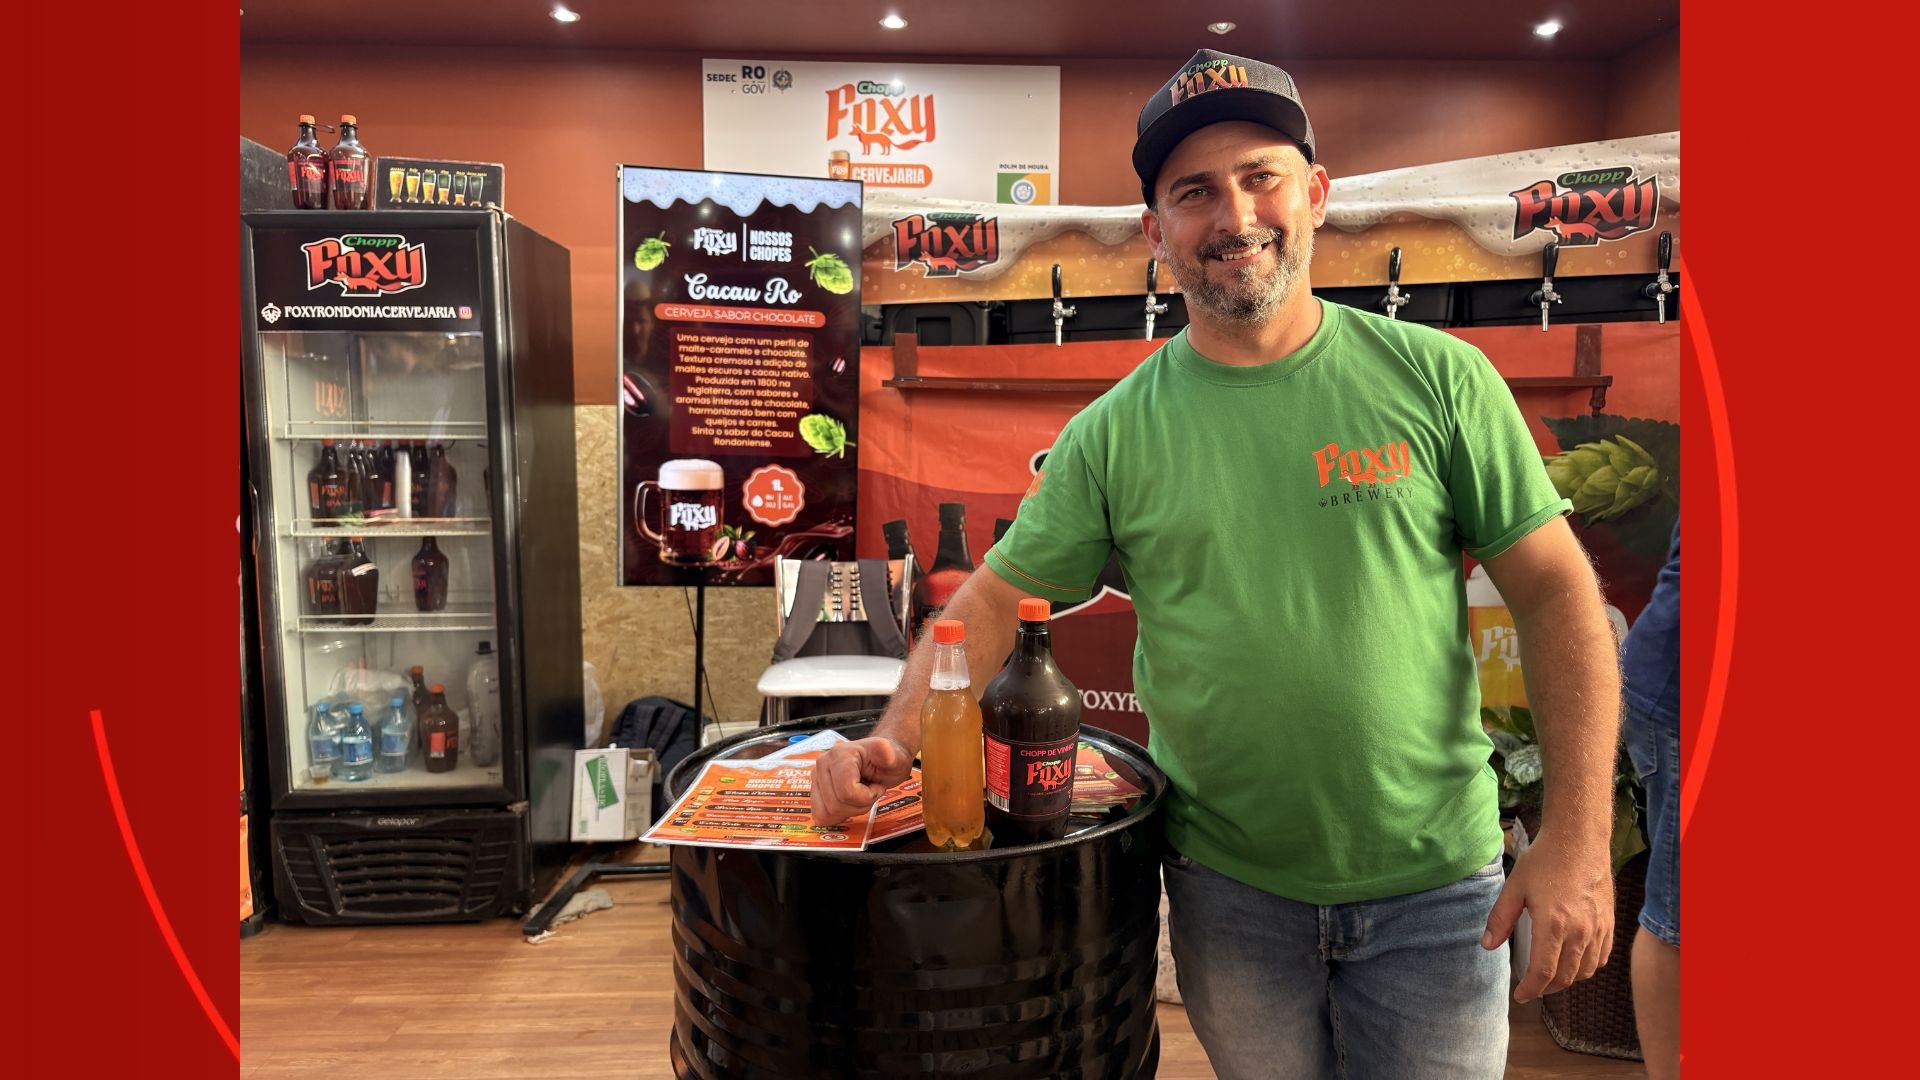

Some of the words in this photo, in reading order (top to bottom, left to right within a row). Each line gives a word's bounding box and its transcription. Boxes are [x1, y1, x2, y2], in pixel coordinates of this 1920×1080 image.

[742, 65, 765, 79] RO
[1187, 59, 1229, 75] Chopp
[706, 73, 737, 82] SEDEC
[742, 84, 766, 94] GOV
[825, 84, 935, 141] Foxy
[853, 167, 925, 184] CERVEJARIA
[1561, 171, 1625, 186] Chopp
[929, 212, 976, 220] Chopp
[1513, 181, 1654, 239] Foxy
[345, 236, 398, 248] Chopp
[693, 227, 737, 253] Foxy
[750, 230, 793, 247] NOSSOS
[894, 215, 997, 266] Foxy
[750, 246, 792, 262] CHOPES
[304, 240, 423, 289] Foxy
[684, 273, 761, 302] Cacau
[764, 277, 802, 304] Ro
[284, 306, 457, 319] FOXYRONDONIACERVEJARIA
[664, 307, 713, 319] CERVEJA
[714, 309, 751, 321] SABOR
[752, 311, 816, 324] CHOCOLATE
[677, 334, 699, 342] Uma
[701, 336, 733, 345] cerveja
[774, 338, 794, 348] perfil
[679, 344, 752, 355] malte-caramelo
[762, 348, 807, 358] chocolate.
[679, 355, 712, 363] Textura
[714, 357, 753, 365] cremosa
[763, 358, 793, 368] adição
[795, 360, 806, 368] de
[675, 365, 706, 374] maltes
[708, 367, 742, 375] escuros
[782, 370, 810, 379] nativo.
[696, 376, 739, 385] Produzida
[758, 379, 777, 387] 1800
[688, 386, 733, 397] Inglaterra,
[756, 389, 791, 398] sabores
[676, 397, 710, 405] aromas
[713, 397, 749, 406] intensos
[765, 399, 810, 409] chocolate,
[689, 407, 753, 416] harmonizando
[755, 408, 775, 417] bem
[778, 410, 797, 418] com
[705, 417, 737, 428] queijos
[692, 426, 714, 435] Sinta
[724, 428, 750, 437] sabor
[751, 429, 763, 437] do
[765, 429, 794, 438] Cacau
[714, 438, 772, 447] Rondoniense.
[1312, 440, 1411, 488] Foxy
[1331, 488, 1414, 507] BREWERY
[670, 502, 717, 526] Foxy
[1048, 748, 1057, 756] DE
[1057, 743, 1075, 753] VINHO
[1026, 757, 1072, 786] Foxy
